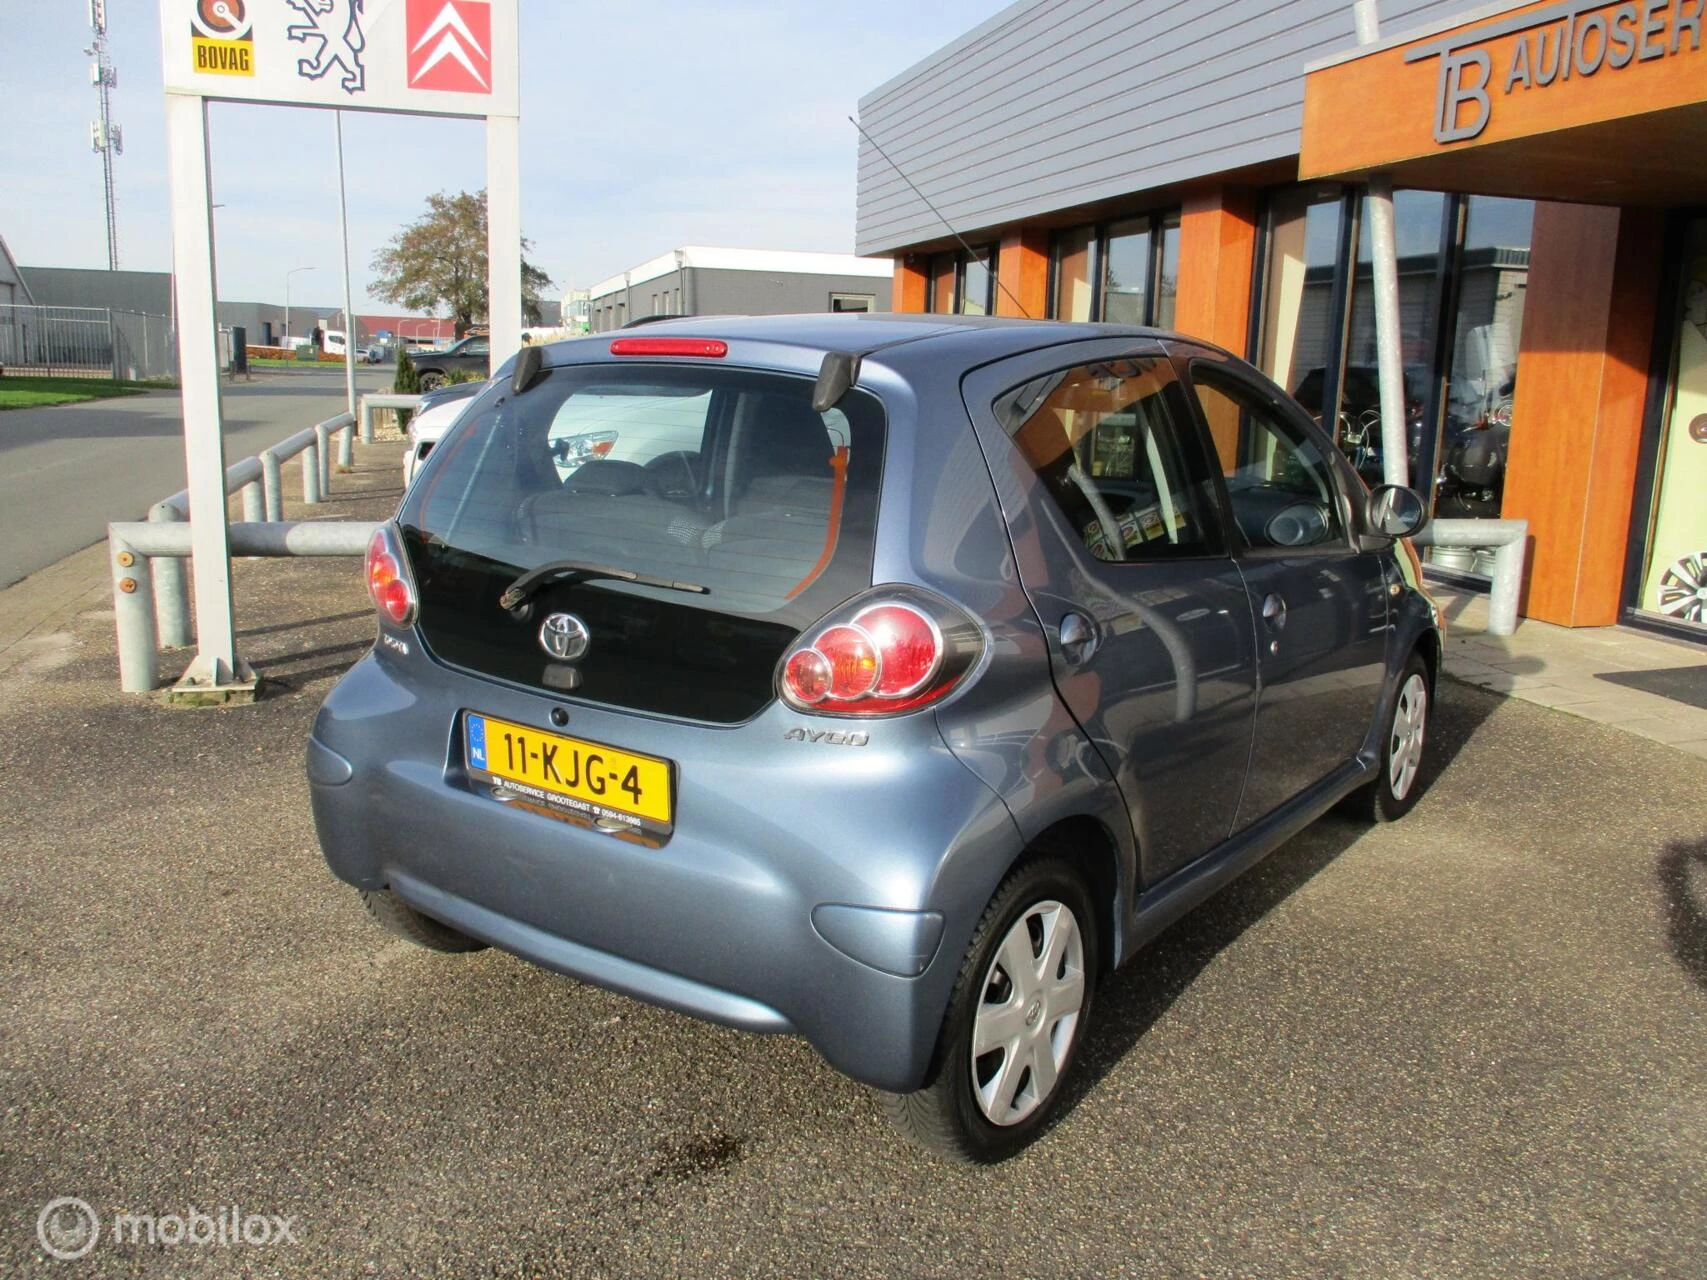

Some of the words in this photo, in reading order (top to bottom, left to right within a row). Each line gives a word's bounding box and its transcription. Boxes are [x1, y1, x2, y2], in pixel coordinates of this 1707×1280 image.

[197, 44, 250, 71] BOVAG
[1503, 0, 1705, 94] AUTOSER
[783, 727, 870, 746] AYGO
[472, 746, 486, 760] NL
[504, 732, 643, 806] 11-KJG-4
[503, 780, 545, 799] AUTOSERVICE
[546, 792, 591, 812] GROOTEGAST
